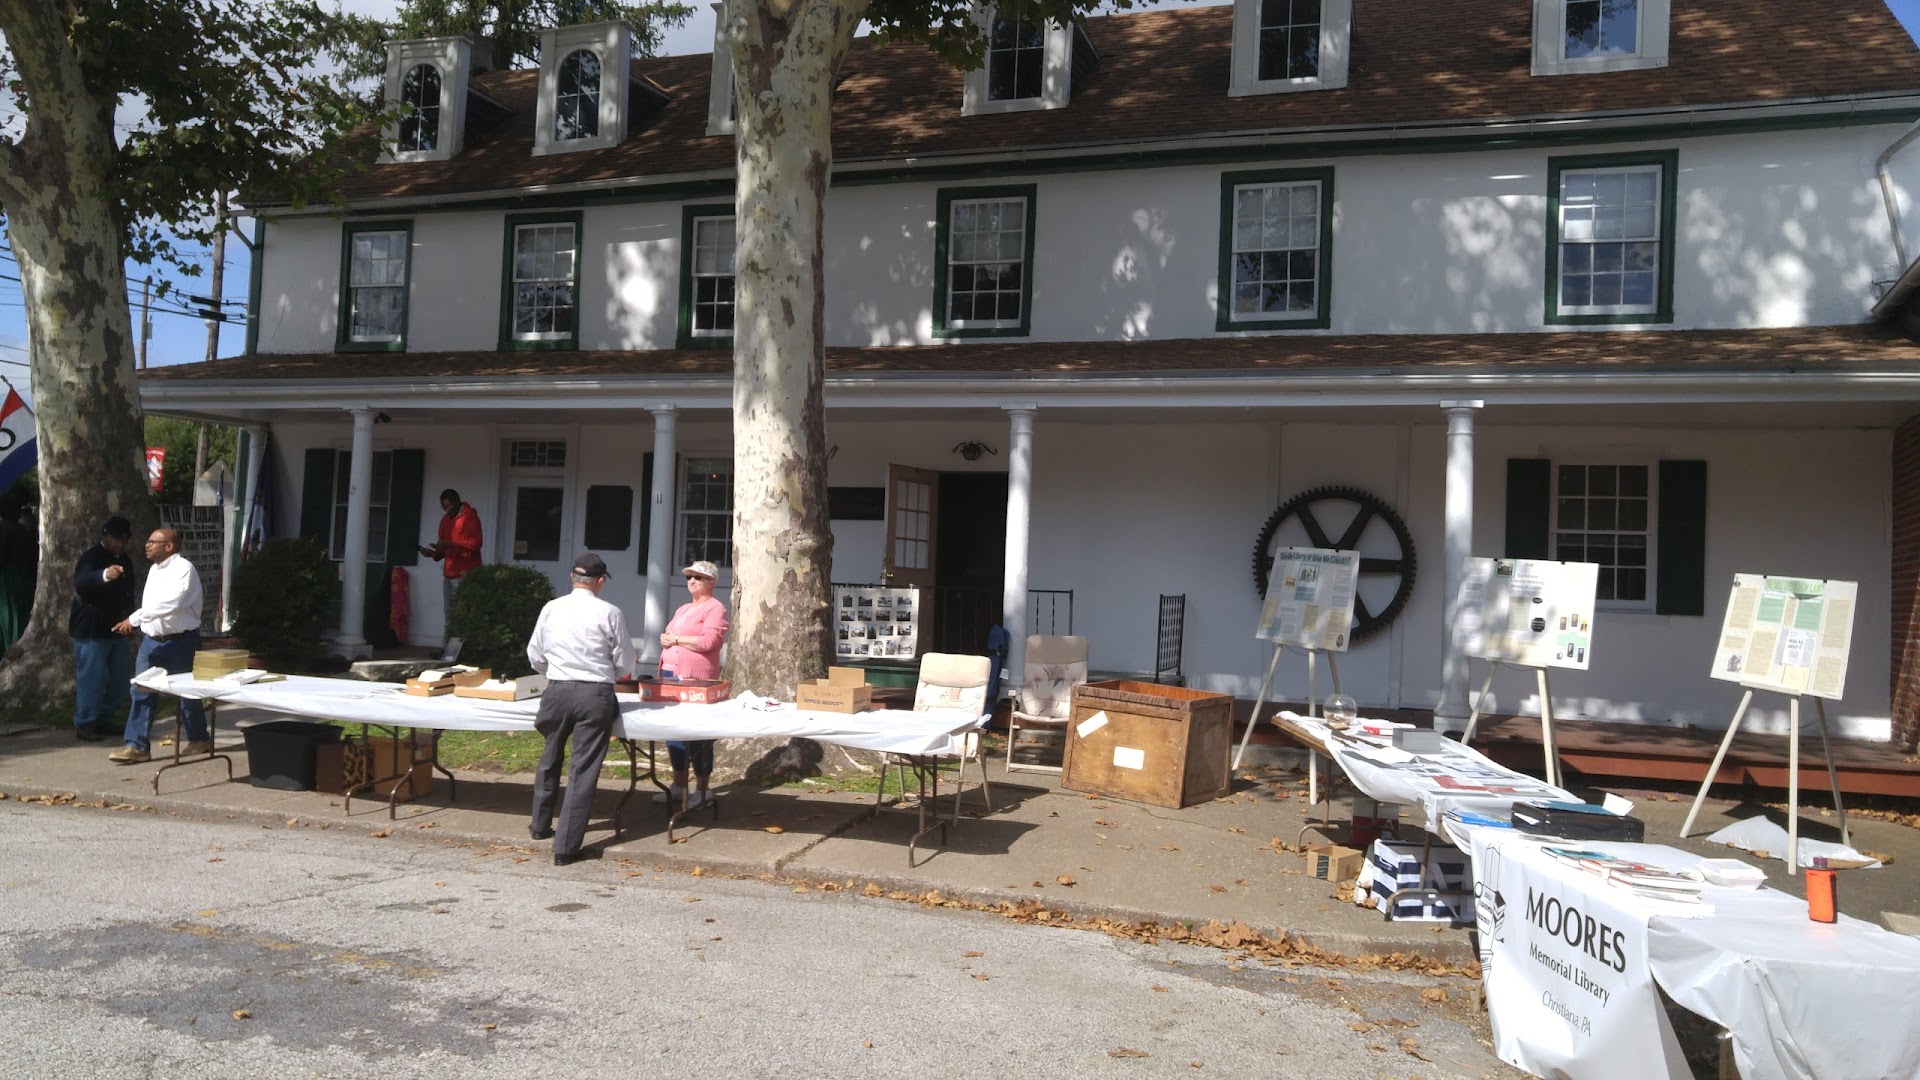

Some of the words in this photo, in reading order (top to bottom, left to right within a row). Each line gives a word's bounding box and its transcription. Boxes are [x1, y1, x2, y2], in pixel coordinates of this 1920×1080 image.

[1525, 886, 1626, 973] MOORES
[1529, 941, 1572, 981] Memorial
[1574, 967, 1610, 1008] Library
[1542, 990, 1580, 1030] Christiana,
[1581, 1016, 1591, 1037] PA
